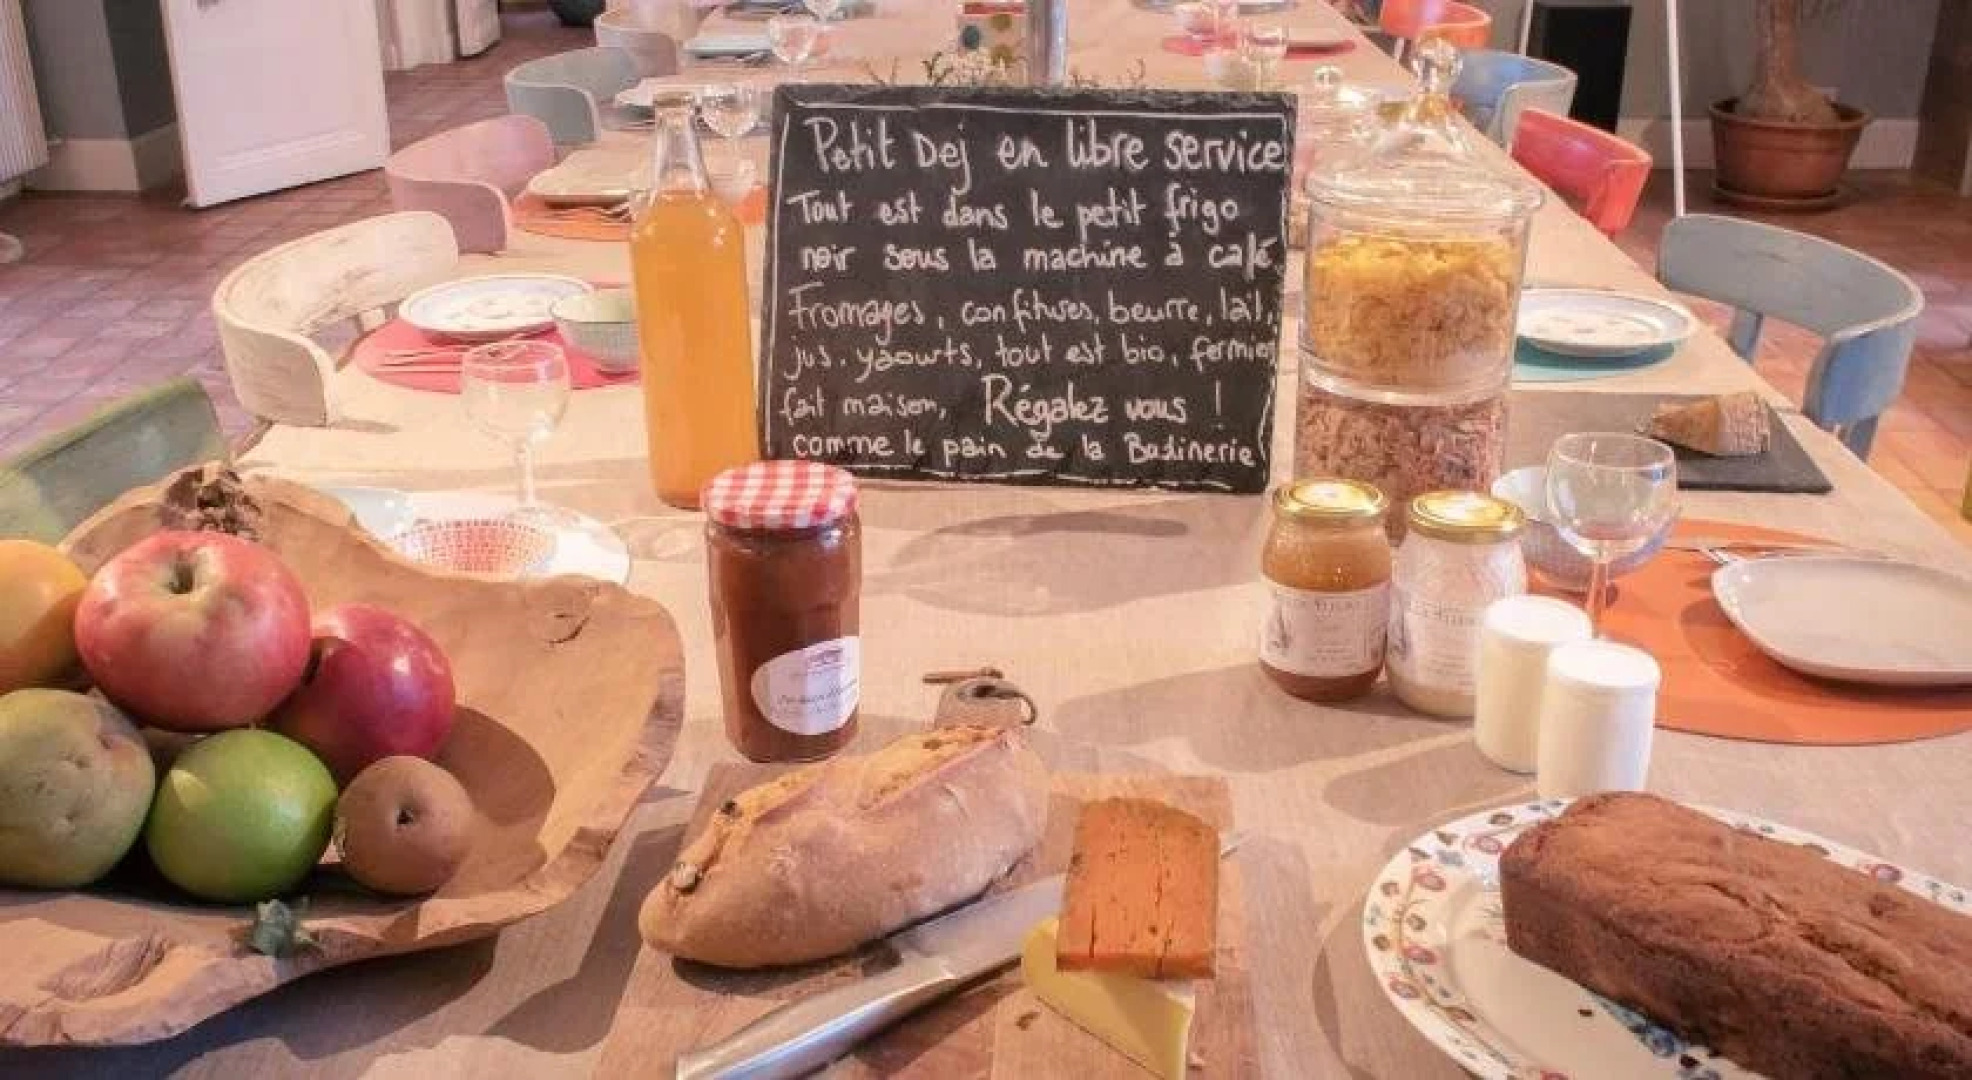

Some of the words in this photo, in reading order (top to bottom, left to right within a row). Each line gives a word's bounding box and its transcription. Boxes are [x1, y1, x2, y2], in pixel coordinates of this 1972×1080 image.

[912, 121, 972, 196] Dej
[998, 135, 1048, 170] en
[1067, 117, 1149, 171] libre
[786, 189, 853, 224] Tout
[880, 189, 923, 226] est
[943, 193, 1008, 230] dans
[1030, 187, 1064, 228] le
[1077, 187, 1147, 243] petit
[1165, 182, 1239, 236] frigo
[802, 244, 856, 271] noir
[967, 237, 997, 271] la
[1023, 239, 1148, 272] machine
[1208, 231, 1277, 282] café
[995, 334, 1052, 367] tout
[1066, 332, 1106, 366] est
[779, 385, 825, 427] fait
[981, 372, 1109, 441] Régalez
[1124, 396, 1188, 424] vous
[792, 434, 895, 457] comme
[903, 429, 926, 454] le
[942, 436, 1007, 467] pain
[1025, 440, 1066, 459] de
[1081, 433, 1105, 460] la
